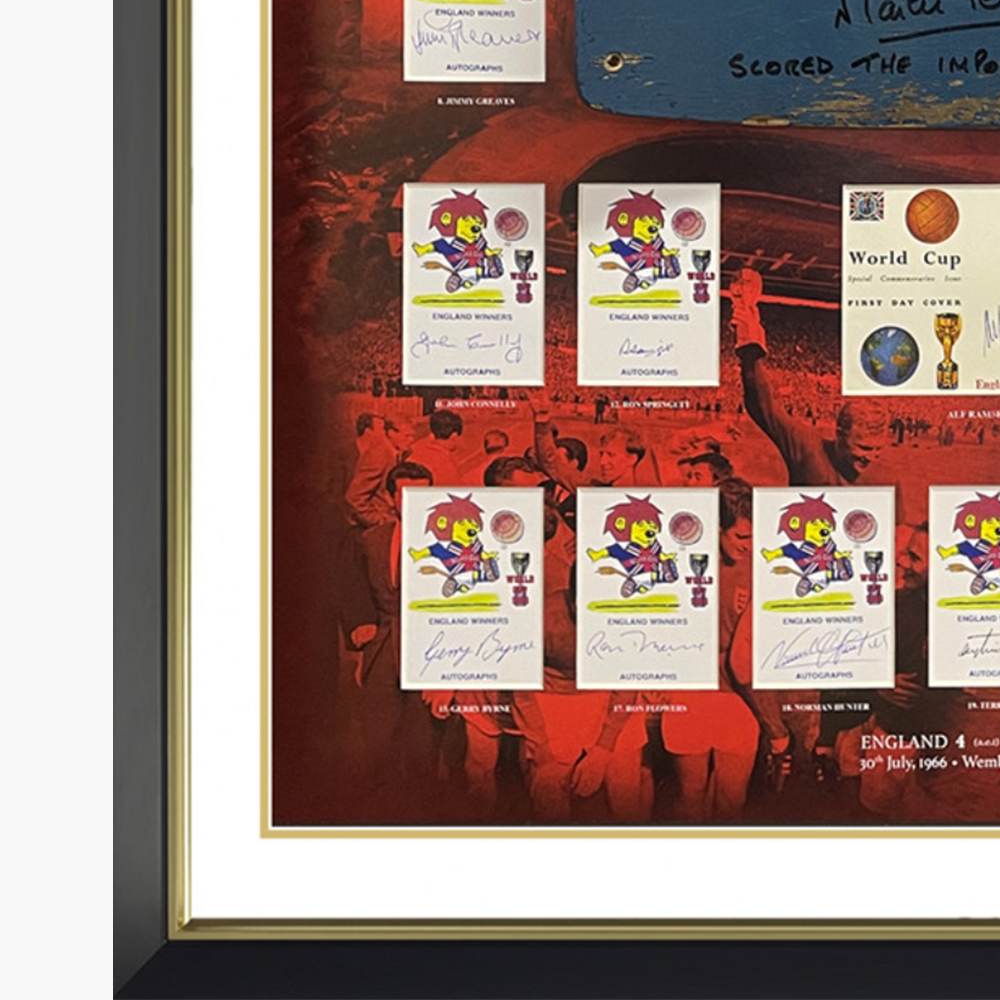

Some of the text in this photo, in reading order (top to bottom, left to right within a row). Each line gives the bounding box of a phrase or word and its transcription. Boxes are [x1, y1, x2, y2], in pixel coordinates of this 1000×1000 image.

[434, 8, 516, 17] ENGLAND WINNERS
[445, 64, 504, 72] AUTOGRAPHS
[728, 52, 834, 79] SCORED
[850, 52, 912, 75] THE
[475, 97, 516, 105] GREAVES
[849, 250, 961, 270] World Cup
[431, 312, 513, 321] ENGLAND WINNERS
[608, 313, 690, 322] ENGLAND WINNERS
[443, 368, 502, 376] AUTOGRAPHS
[620, 369, 679, 377] AUTOGRAPHS
[470, 399, 516, 408] CONNELLY
[949, 410, 965, 419] ALF
[428, 617, 510, 626] ENGLAND WINNERS
[607, 617, 689, 626] ENGLAND WINNERS
[782, 616, 864, 625] ENGLAND WINNERS
[956, 614, 997, 623] ENGLAND
[440, 673, 499, 681] AUTOGRAPHS
[619, 673, 678, 681] AUTOGRAPHS
[795, 672, 854, 680] AUTOGRAPHS
[794, 703, 832, 712] NORMAN
[834, 703, 870, 712] HUNTER
[861, 734, 948, 749] ENGLAND
[955, 733, 965, 749] 4
[887, 755, 916, 772] July,
[919, 756, 948, 771] 1966
